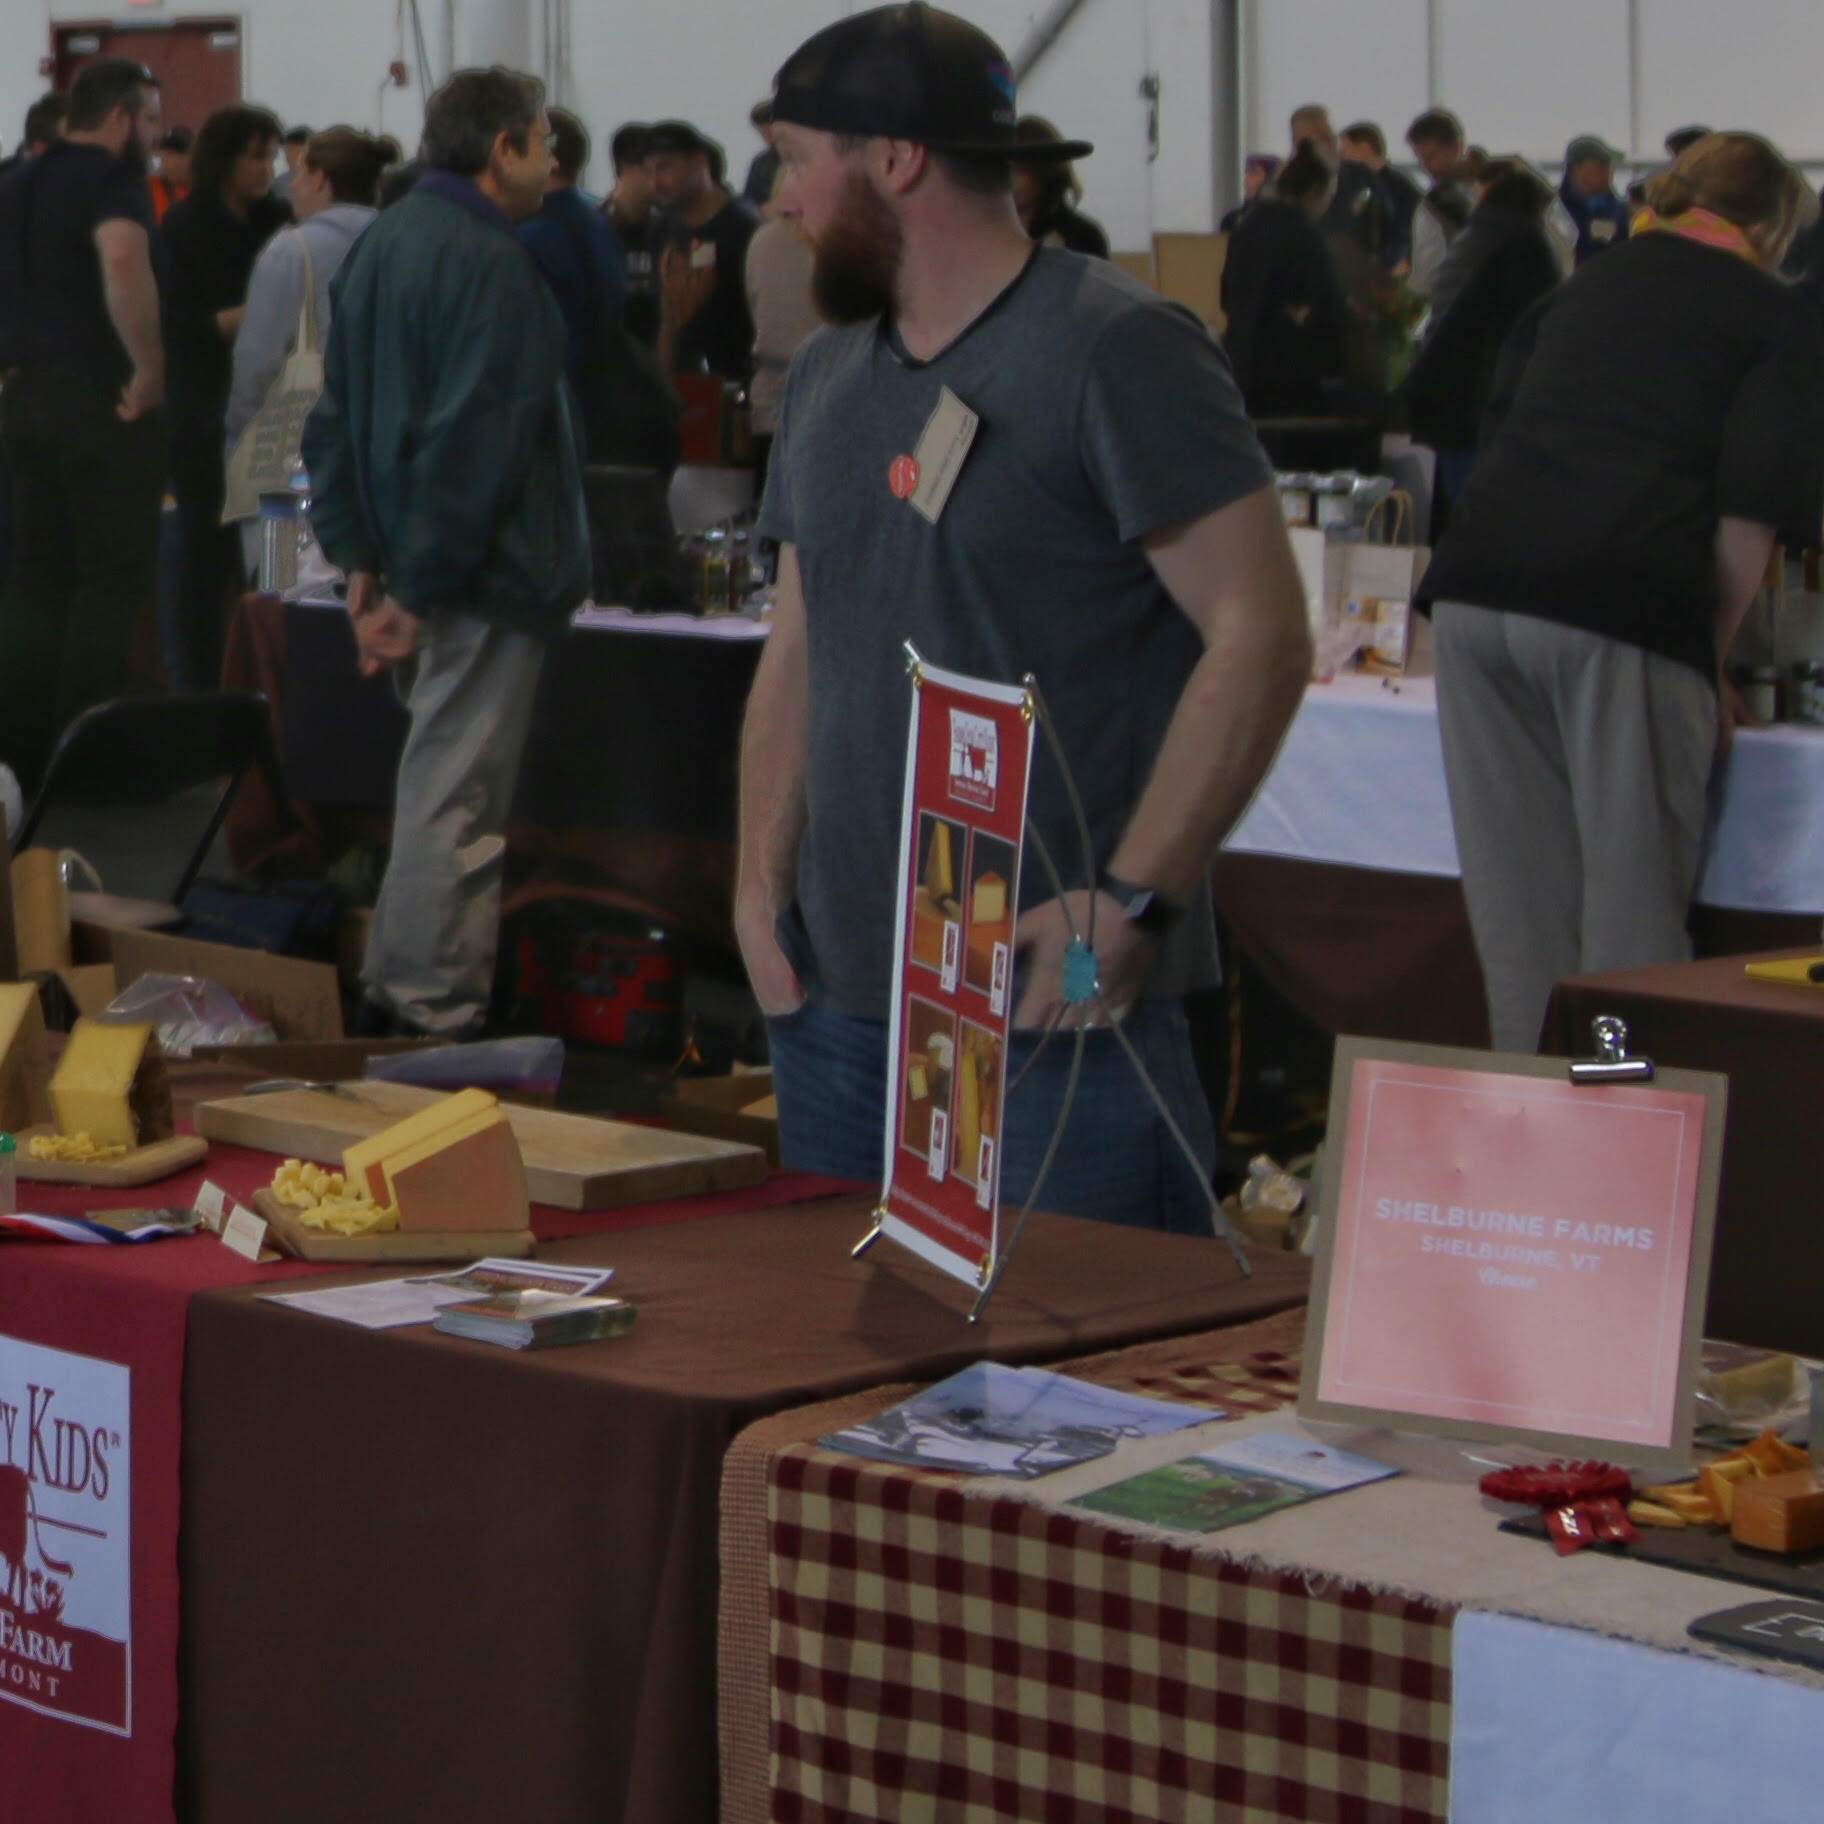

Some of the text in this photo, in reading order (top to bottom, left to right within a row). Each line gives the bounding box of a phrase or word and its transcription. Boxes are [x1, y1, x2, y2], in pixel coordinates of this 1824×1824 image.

[1375, 1197, 1657, 1250] SHELBURNE FARMS
[1420, 1235, 1601, 1273] SHELBURNE, VT
